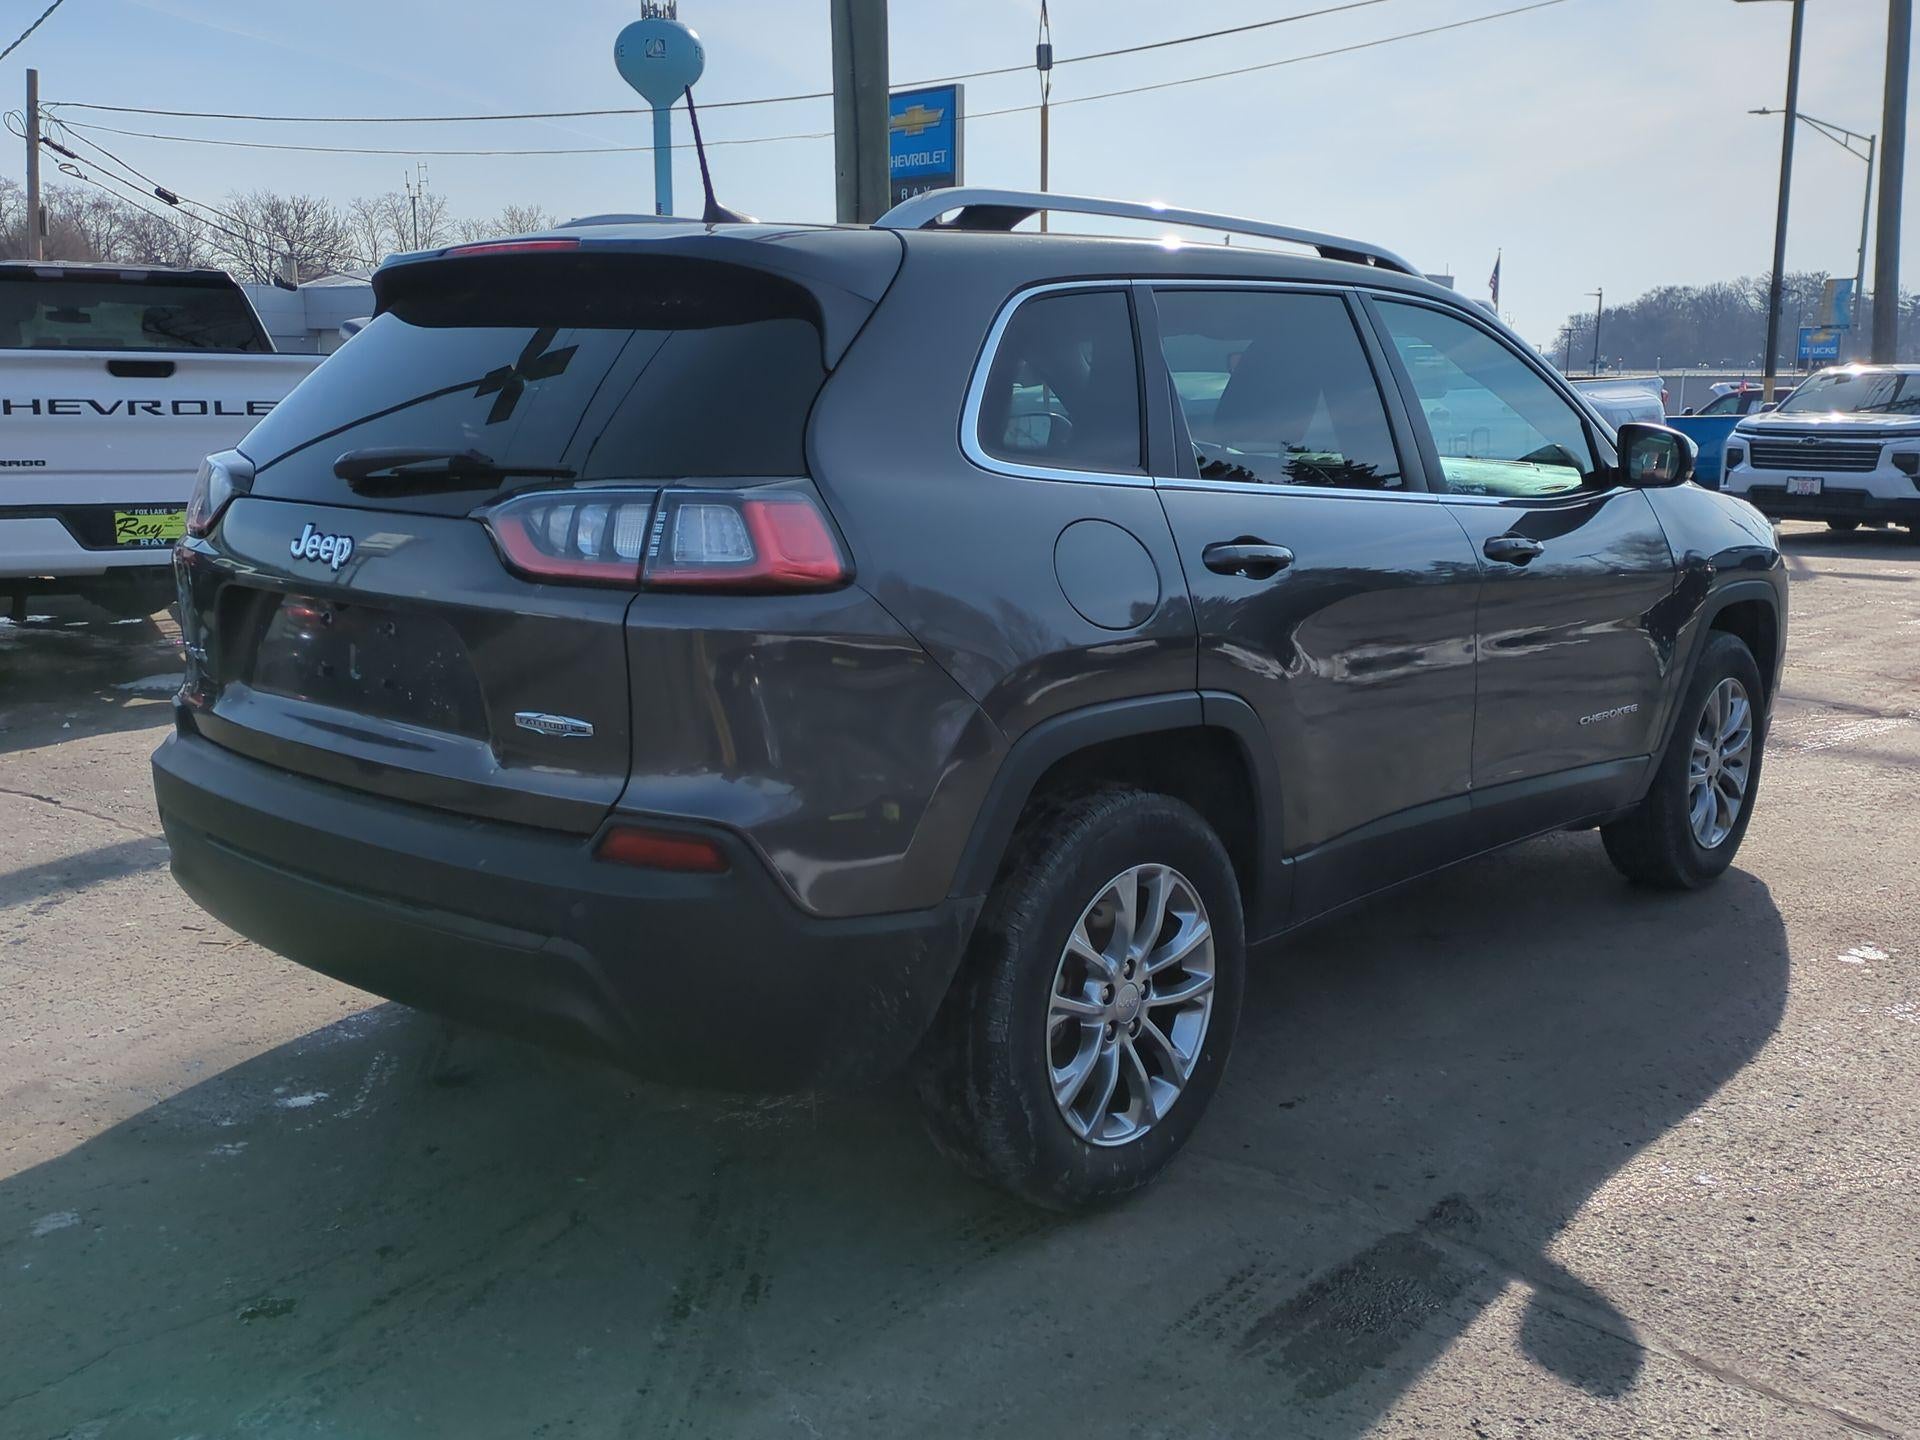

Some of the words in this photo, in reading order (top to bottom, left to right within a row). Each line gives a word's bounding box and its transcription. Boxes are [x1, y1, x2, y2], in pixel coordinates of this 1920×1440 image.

[2, 398, 278, 416] HEVROLE
[116, 517, 165, 539] Ray
[140, 538, 167, 546] RAY
[290, 523, 354, 571] Jeep
[1579, 703, 1639, 725] CHEROKEE
